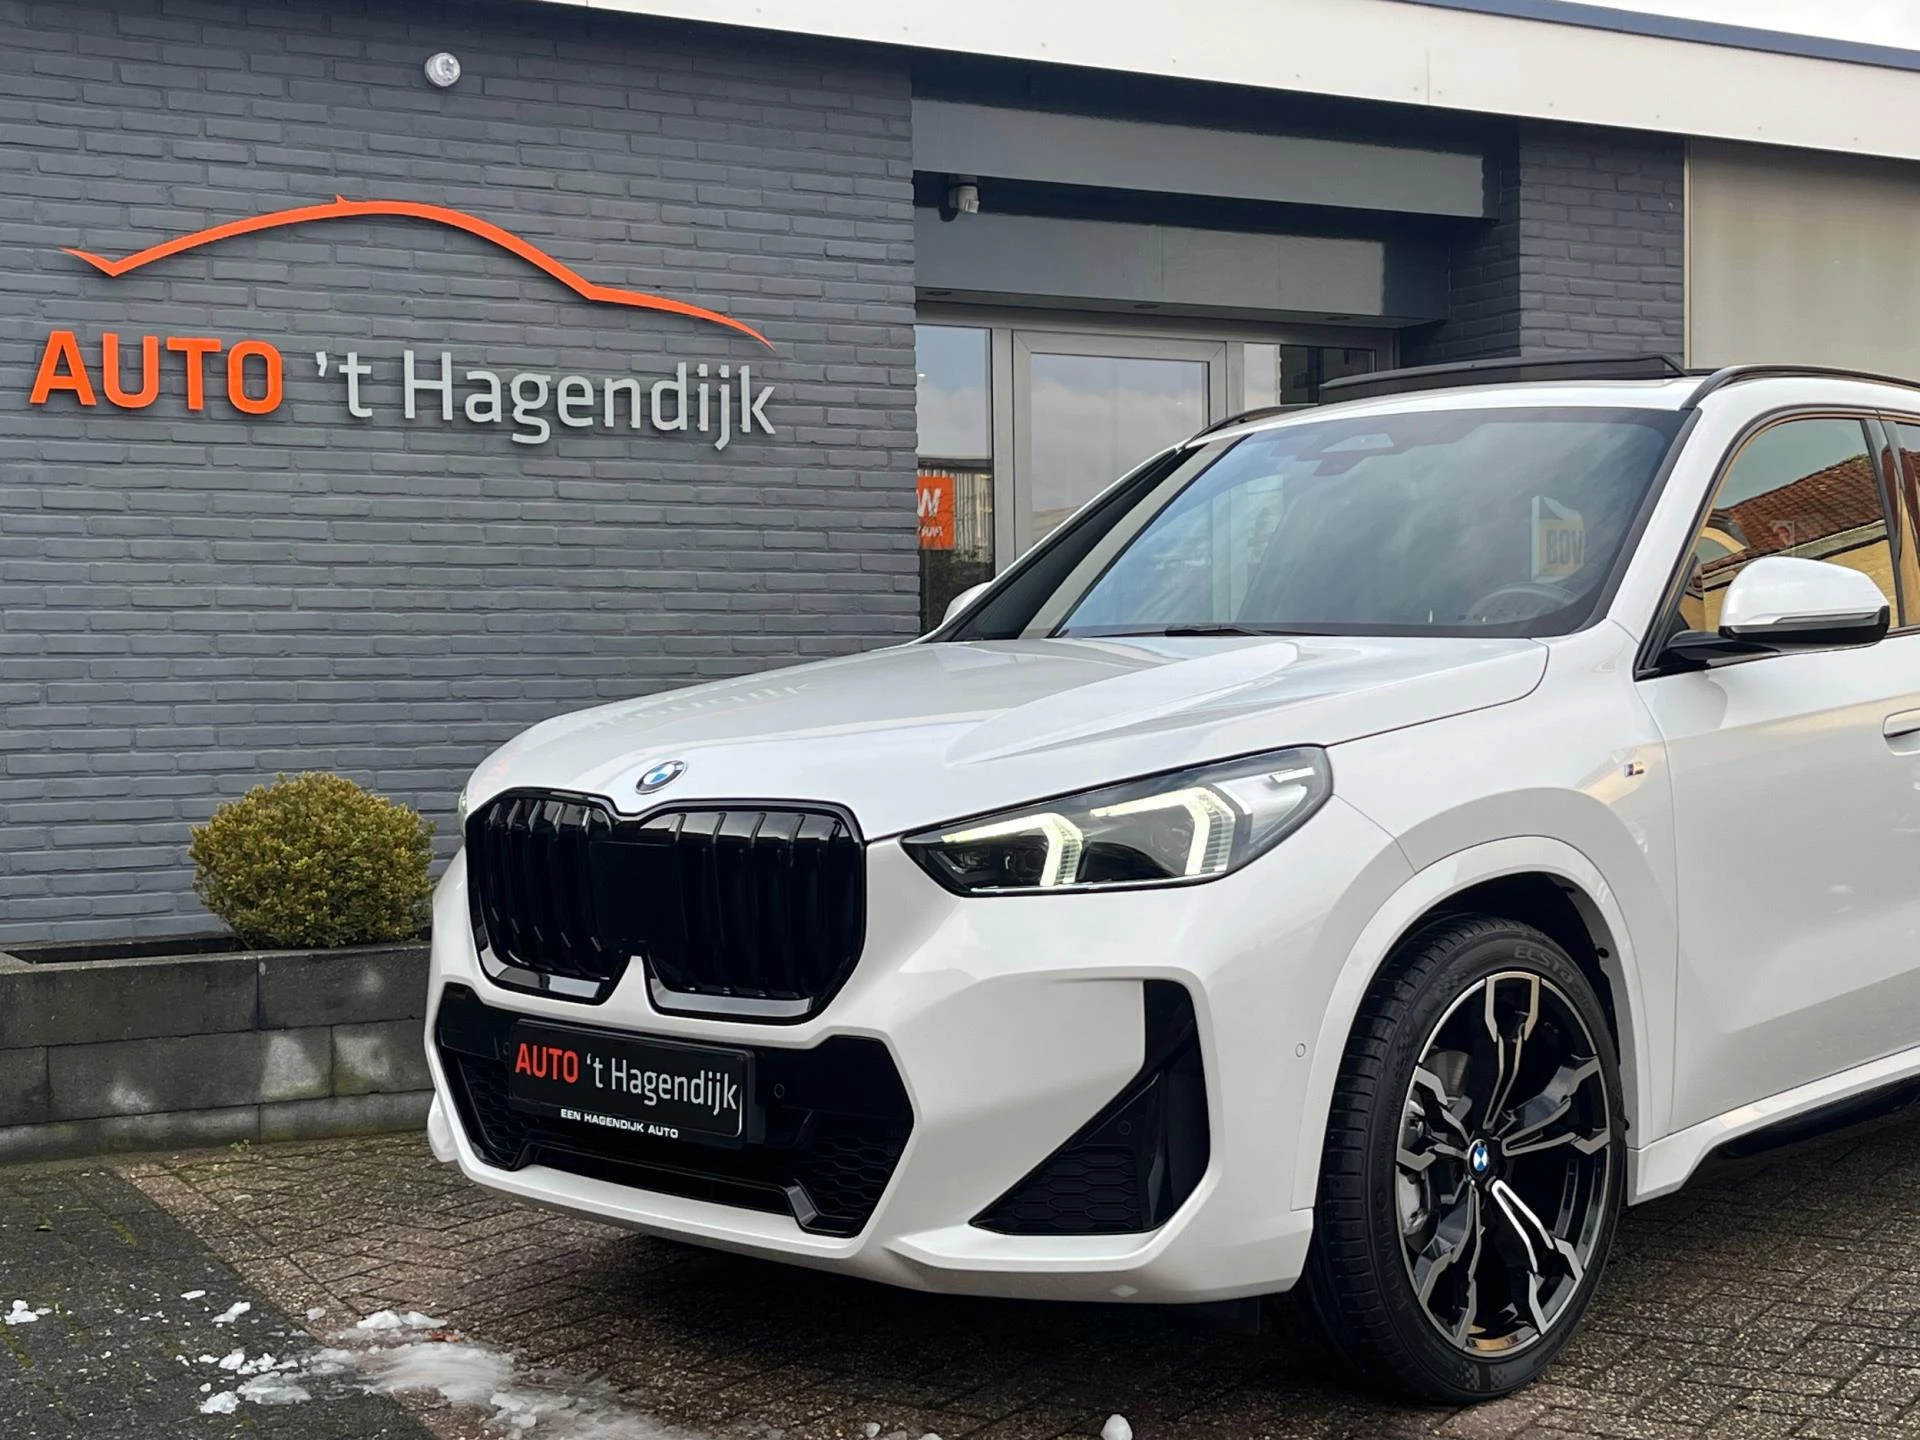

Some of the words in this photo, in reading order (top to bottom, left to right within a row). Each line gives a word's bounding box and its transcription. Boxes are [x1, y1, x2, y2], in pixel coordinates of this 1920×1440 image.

[30, 330, 284, 415] AUTO
[315, 350, 374, 418] 't
[403, 350, 777, 451] Hagendijk
[515, 1043, 579, 1083] AUTO
[611, 1057, 738, 1116] Hagendijk
[560, 1108, 581, 1121] EEN
[584, 1113, 645, 1133] HAGENDIJK
[647, 1124, 679, 1139] AUTO
